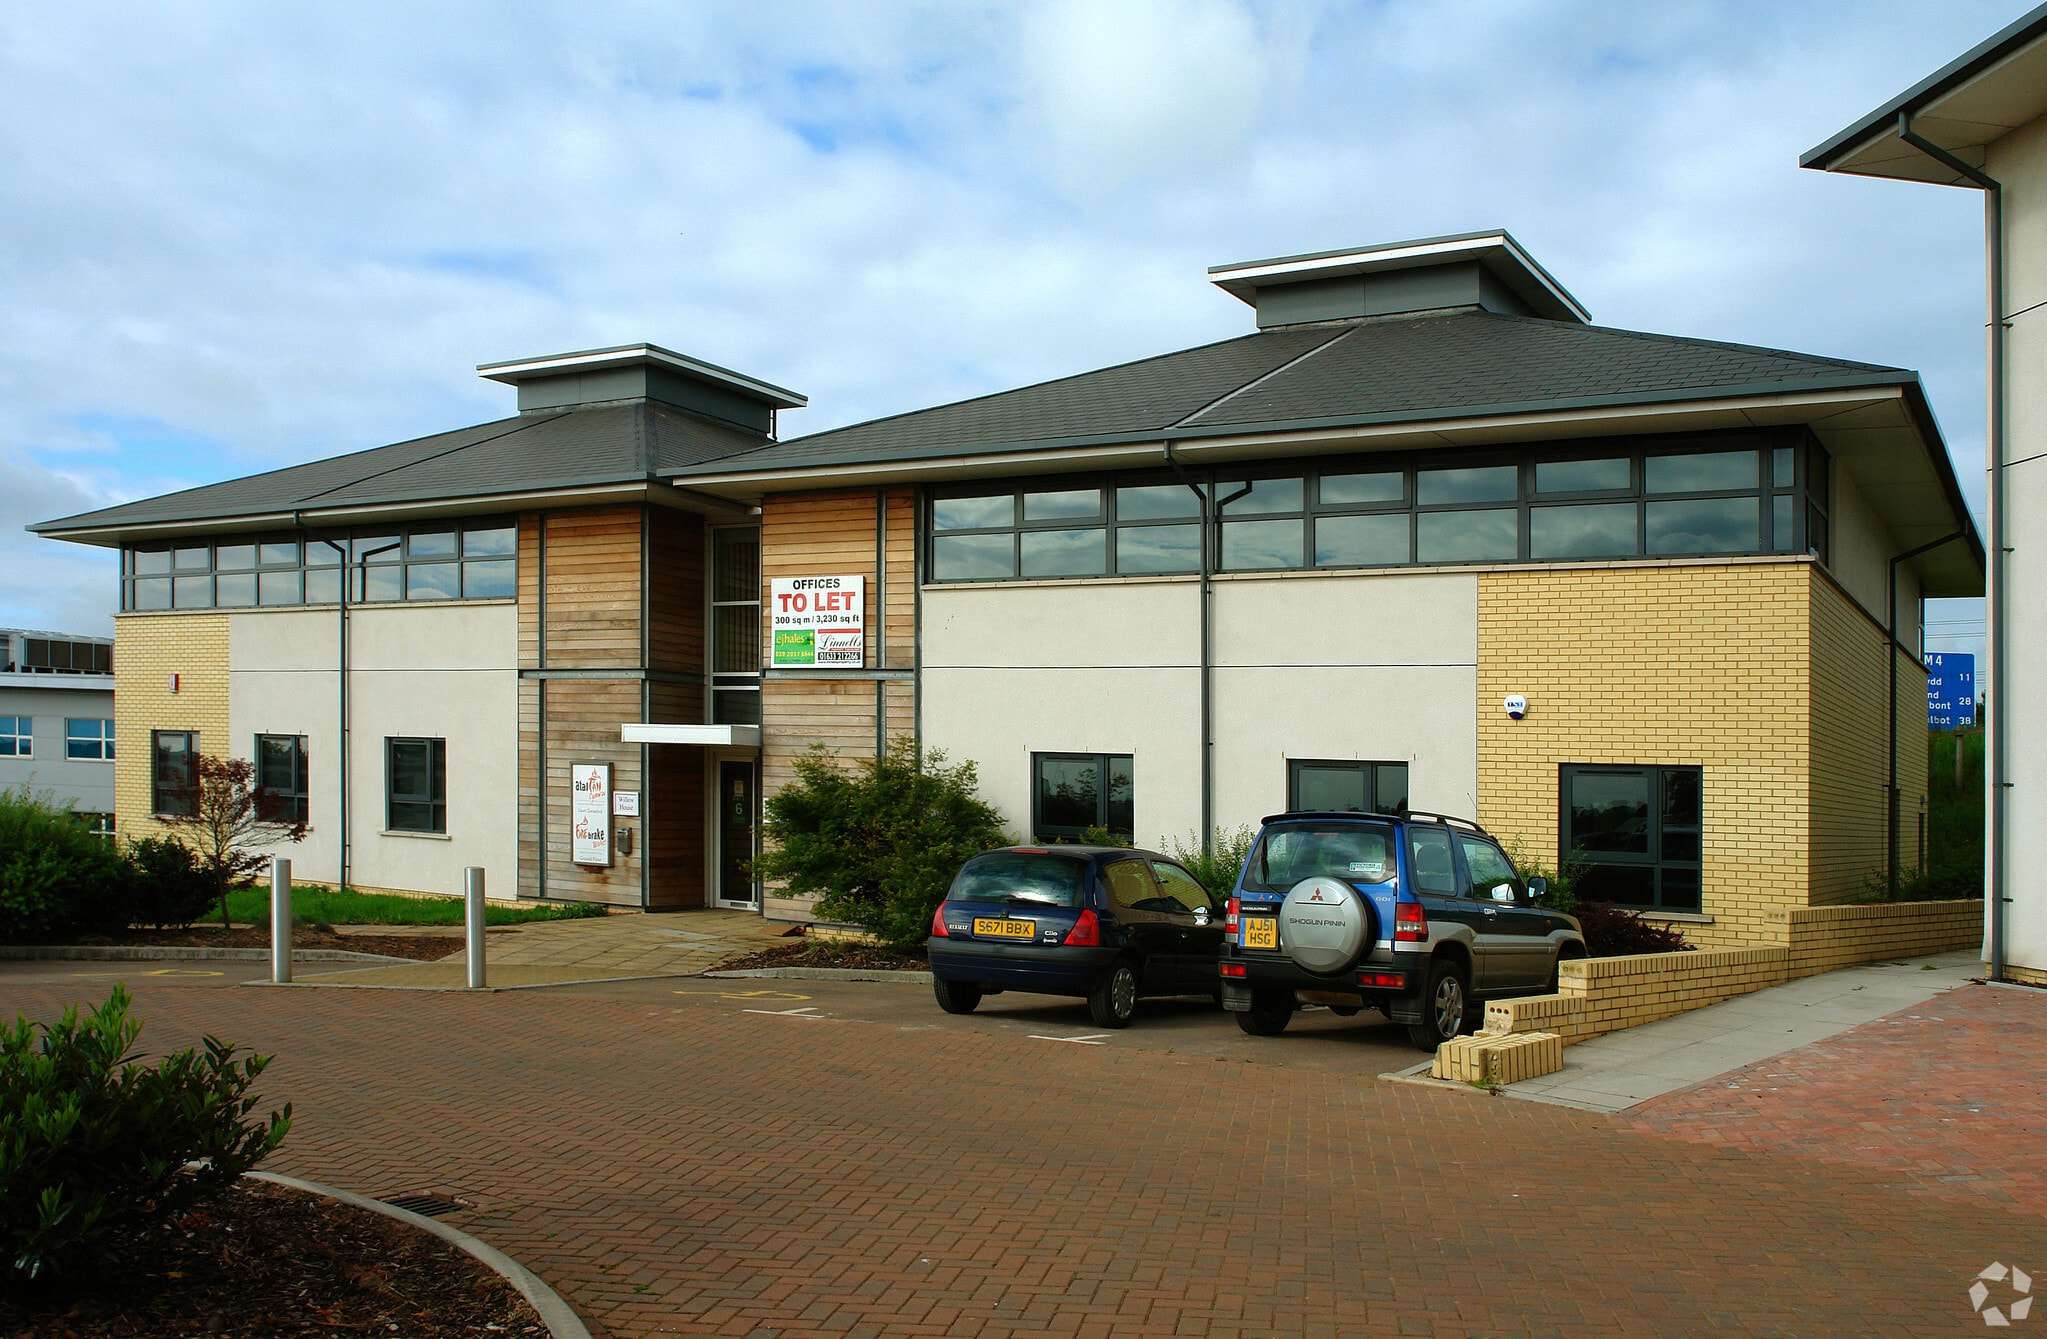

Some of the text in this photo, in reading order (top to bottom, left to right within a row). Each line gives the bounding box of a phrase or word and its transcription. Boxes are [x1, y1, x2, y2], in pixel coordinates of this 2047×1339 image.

[793, 578, 840, 590] OFFICES
[778, 591, 856, 612] TO LET
[775, 616, 790, 624] 300
[816, 615, 838, 624] 3,230
[852, 614, 860, 622] ft
[776, 633, 805, 646] ejhales
[1960, 673, 1970, 681] 11
[1959, 697, 1971, 705] 28
[1928, 716, 1971, 725] lbot 38
[735, 803, 743, 815] 6
[978, 920, 1030, 935] S671 BBX
[1249, 920, 1273, 931] AJ51
[1289, 917, 1346, 927] SHOGUN PININ
[1250, 932, 1271, 945] HSG
